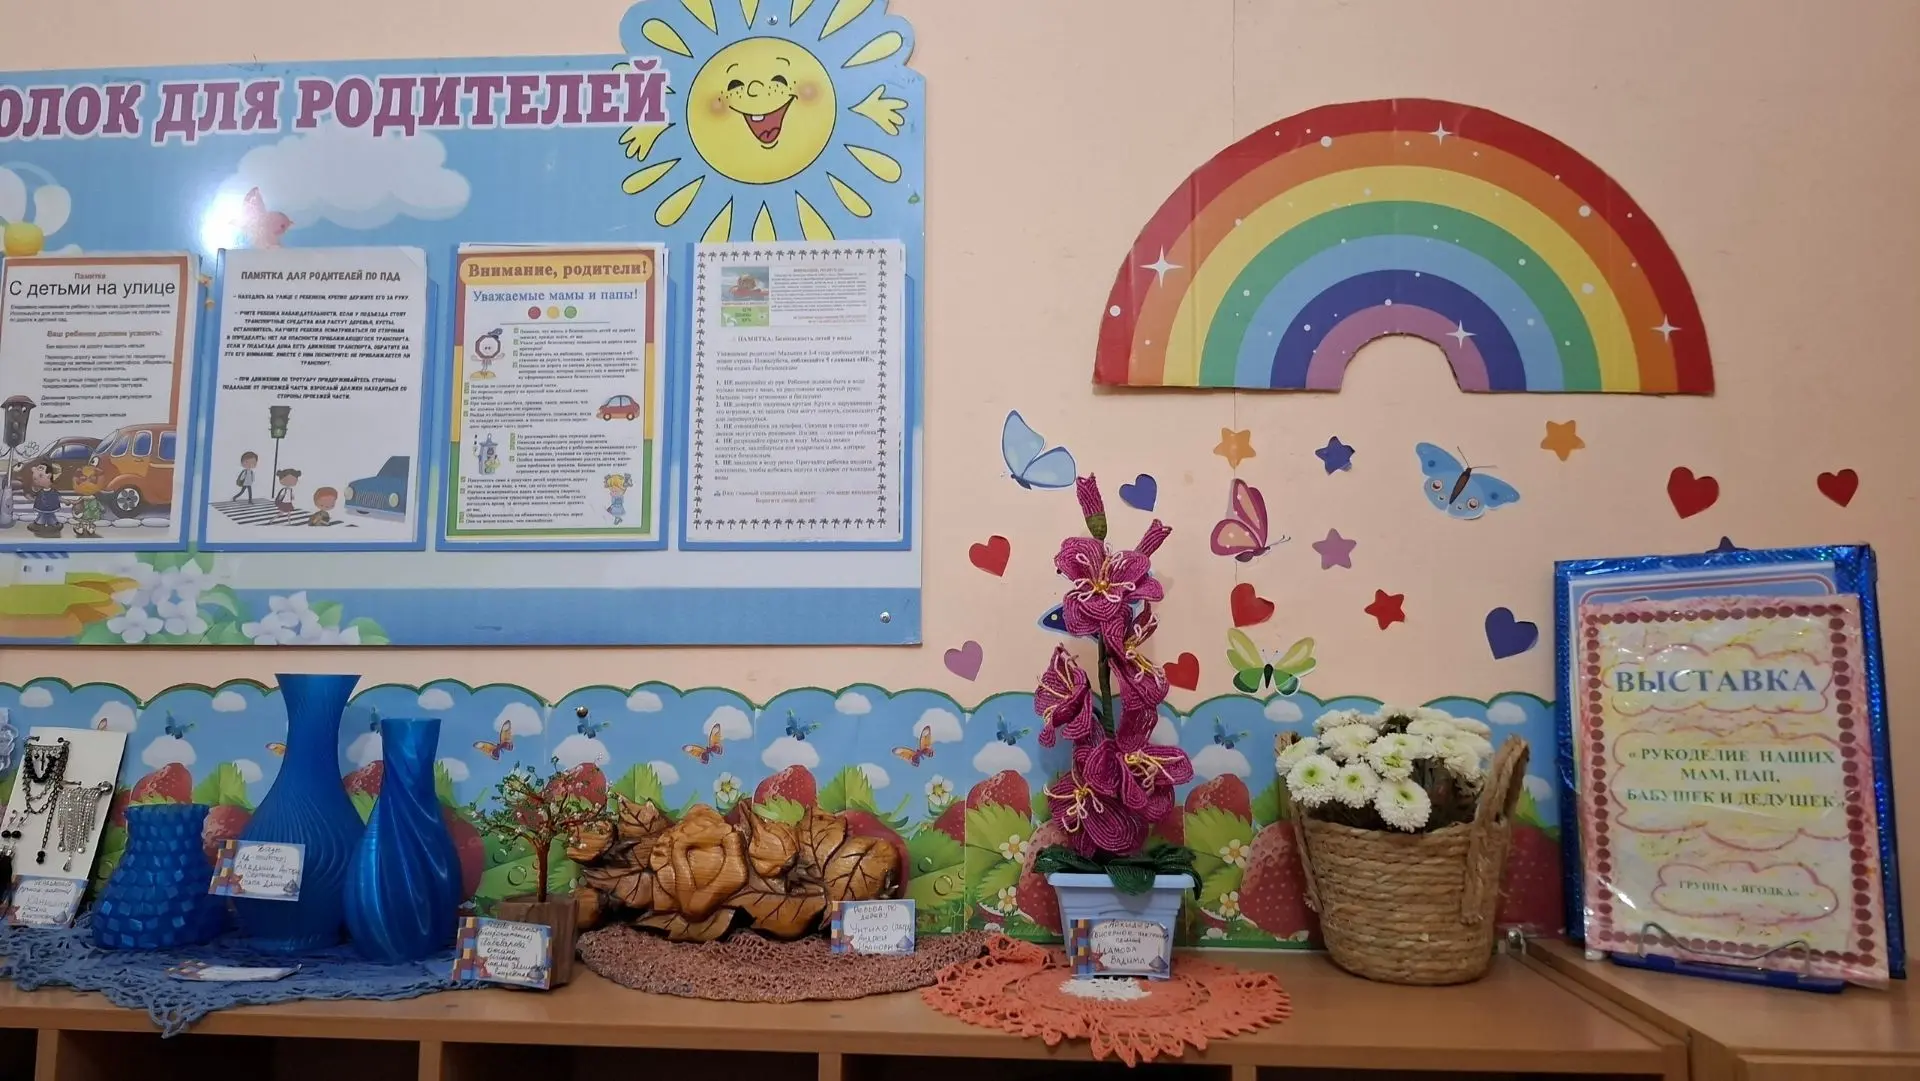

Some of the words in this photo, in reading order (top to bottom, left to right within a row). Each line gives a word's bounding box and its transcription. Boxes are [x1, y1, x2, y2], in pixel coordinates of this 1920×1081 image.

[0, 84, 142, 138] ОЛОК
[154, 80, 281, 142] ДЛЯ
[295, 60, 666, 137] РОДИТЕЛЕЙ
[241, 272, 283, 280] ПАМЯТКА
[286, 272, 306, 280] ДЛЯ
[309, 272, 363, 281] РОДИТЕЛЕЙ
[366, 272, 377, 280] ПО
[380, 272, 400, 282] ПДД
[468, 264, 558, 279] Внимание,
[562, 260, 647, 279] родители!
[10, 281, 22, 296] С
[27, 283, 91, 298] детьми
[97, 282, 117, 295] на
[123, 282, 175, 298] улице
[473, 291, 544, 302] Уважаемые
[549, 290, 584, 300] мамы
[589, 291, 596, 300] и
[600, 288, 638, 300] папы!
[1615, 669, 1817, 693] ВЫСТАВКА
[1641, 748, 1749, 762] РУКОДЕЛИЕ
[1760, 751, 1836, 764] НАШИХ
[1680, 768, 1730, 782] МАМ,
[1736, 770, 1780, 784] ПАП,
[1627, 788, 1717, 804] БАБУШЕК
[1721, 792, 1732, 804] И
[1680, 880, 1728, 892] ГРУППА
